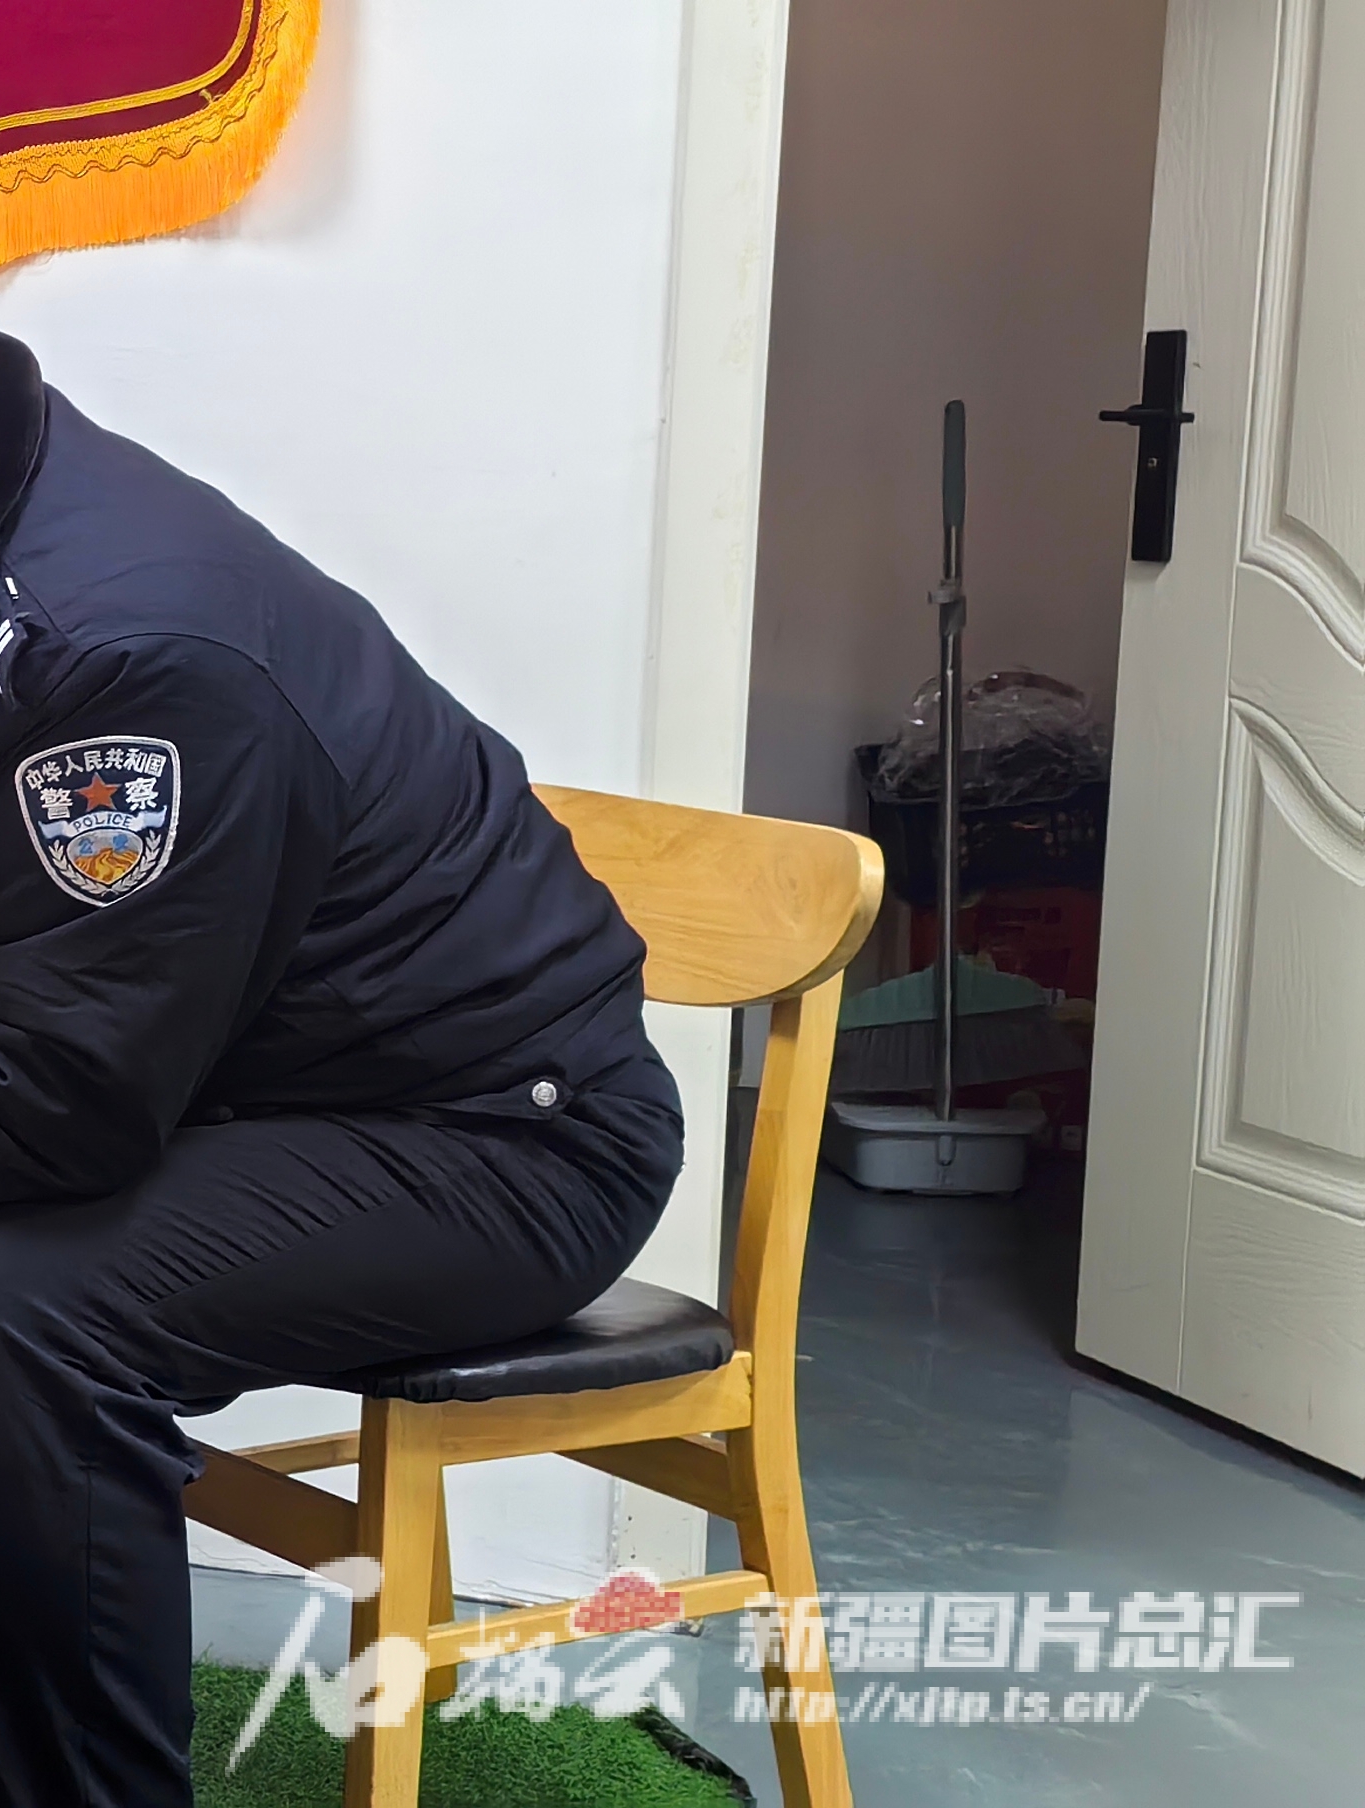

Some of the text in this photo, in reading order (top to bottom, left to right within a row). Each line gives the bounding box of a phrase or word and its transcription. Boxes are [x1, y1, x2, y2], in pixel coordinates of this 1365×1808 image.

[25, 747, 167, 791] 中华人民共和国
[72, 813, 134, 833] POLICE
